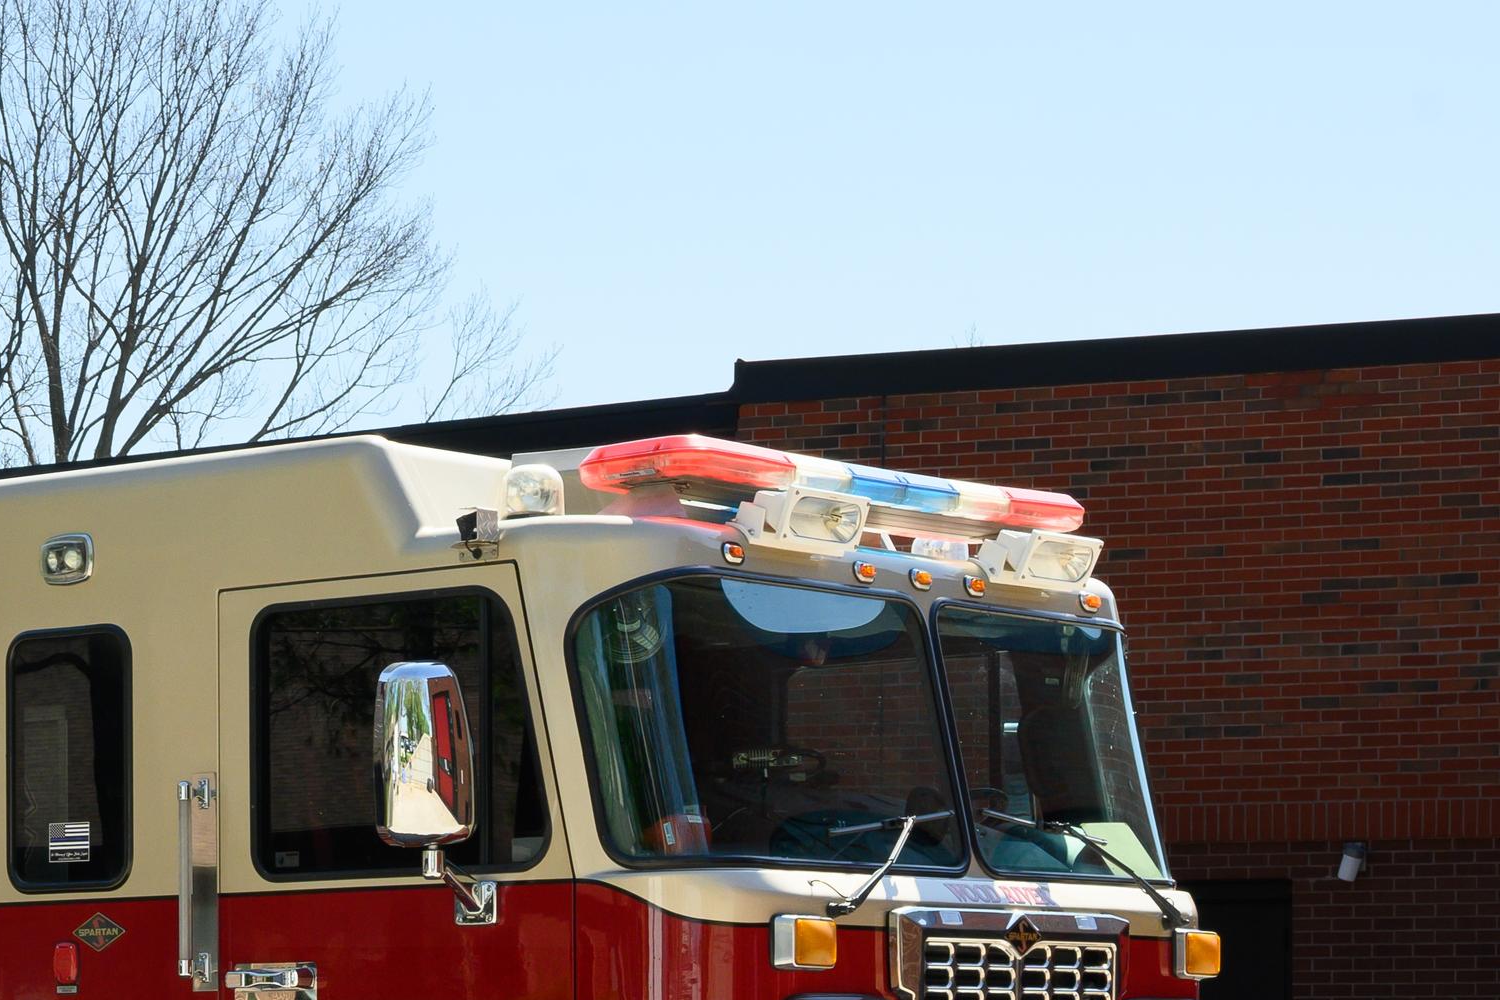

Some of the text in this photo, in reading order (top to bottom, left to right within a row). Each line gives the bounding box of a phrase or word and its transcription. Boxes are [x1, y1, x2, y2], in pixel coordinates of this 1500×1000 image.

[943, 883, 1002, 903] WOOD
[78, 928, 119, 937] SPARTAN
[1008, 931, 1039, 942] SPARTAN
